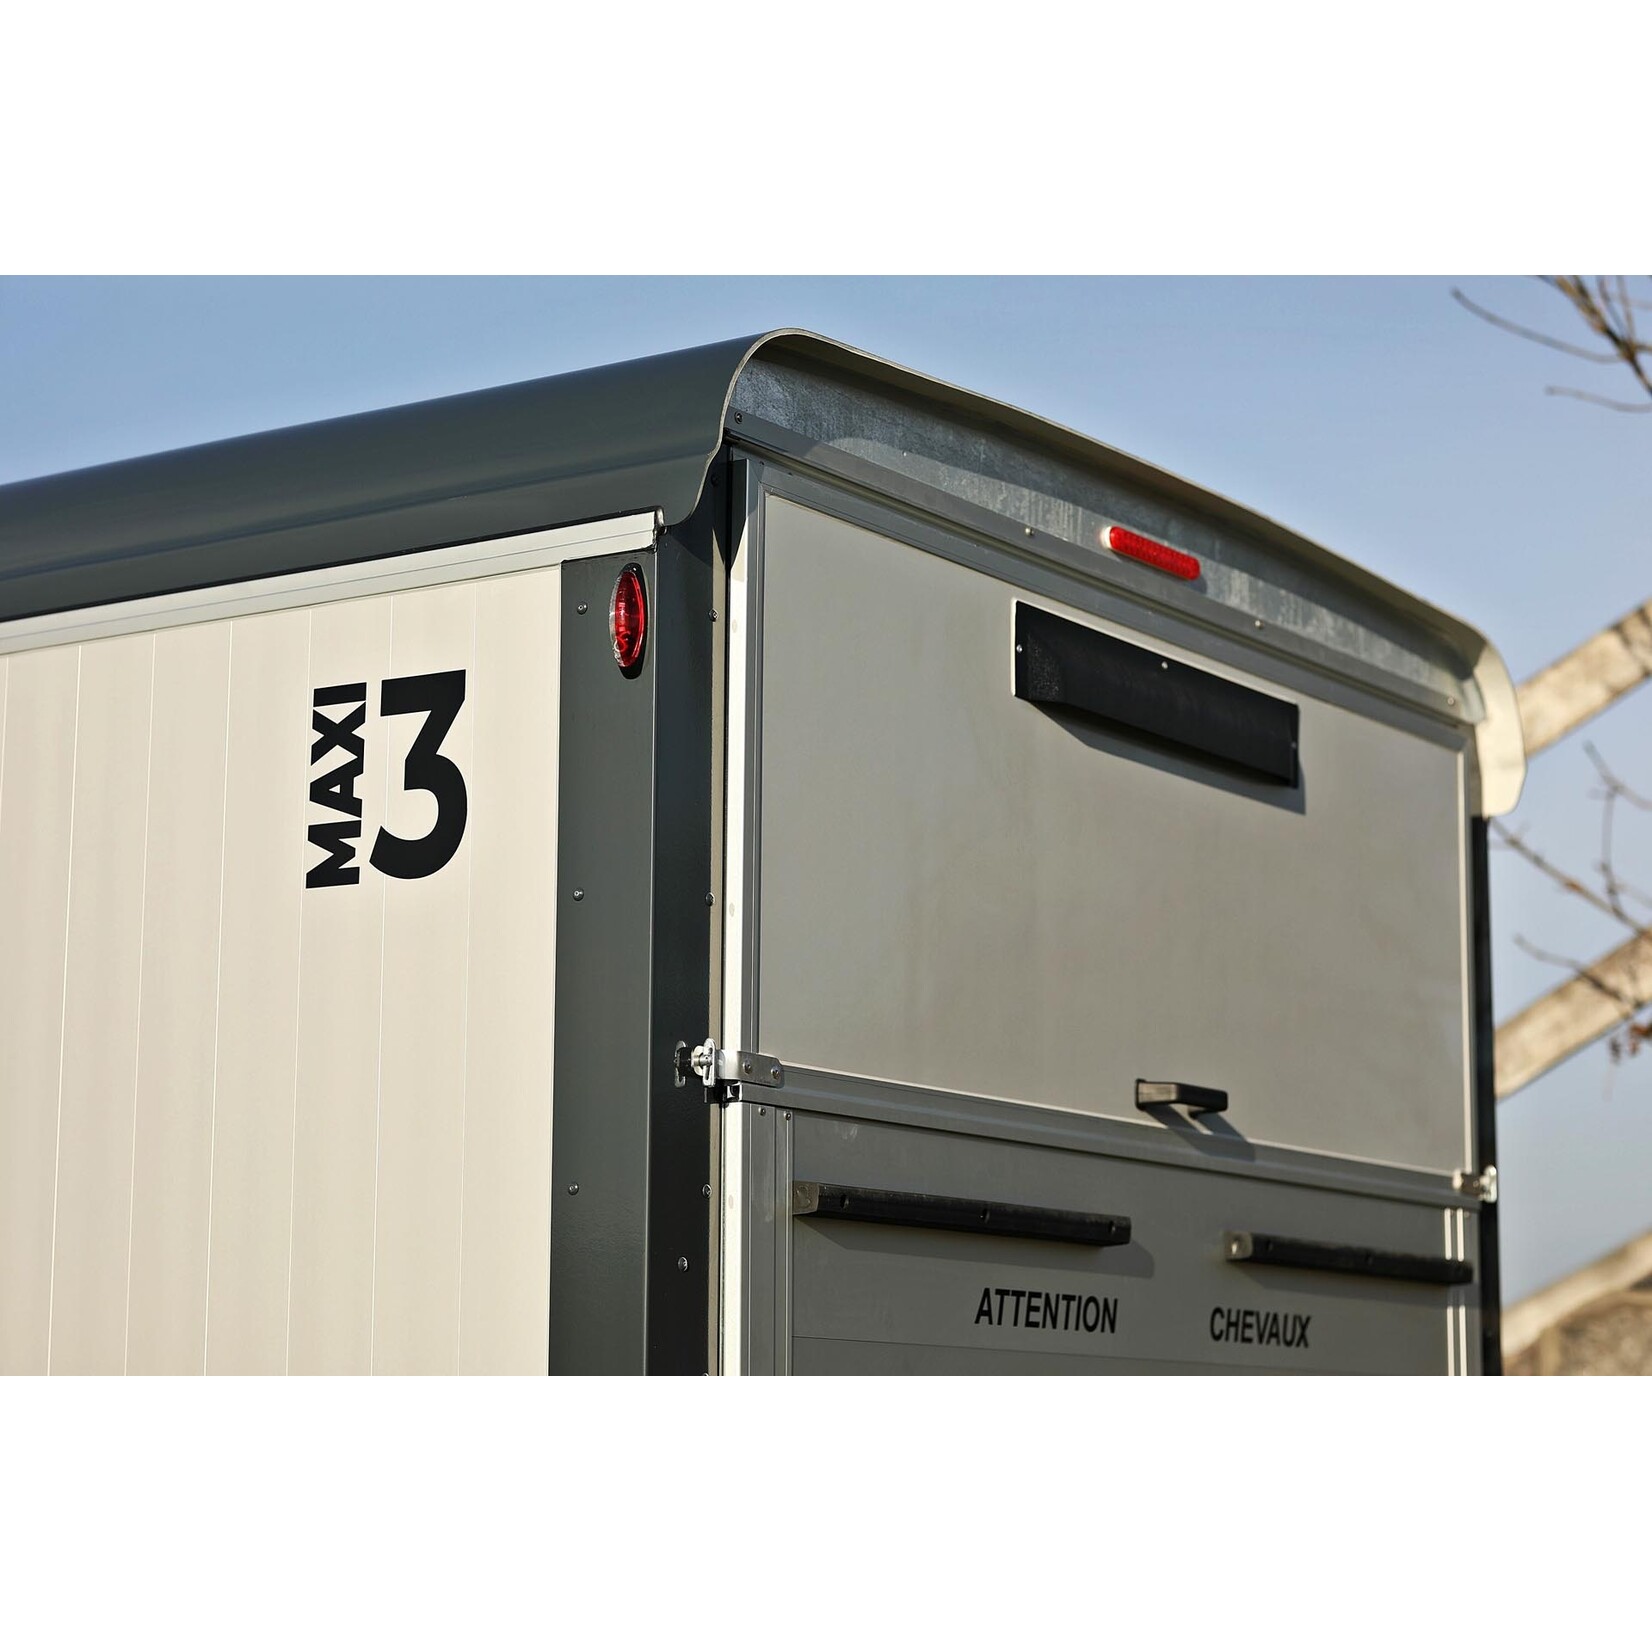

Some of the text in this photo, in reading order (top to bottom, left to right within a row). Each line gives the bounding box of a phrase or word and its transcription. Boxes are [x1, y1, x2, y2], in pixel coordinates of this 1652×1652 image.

[306, 682, 367, 888] MAXI
[369, 669, 467, 879] 3
[974, 1288, 1312, 1348] ATTENTION CHEVAUX
